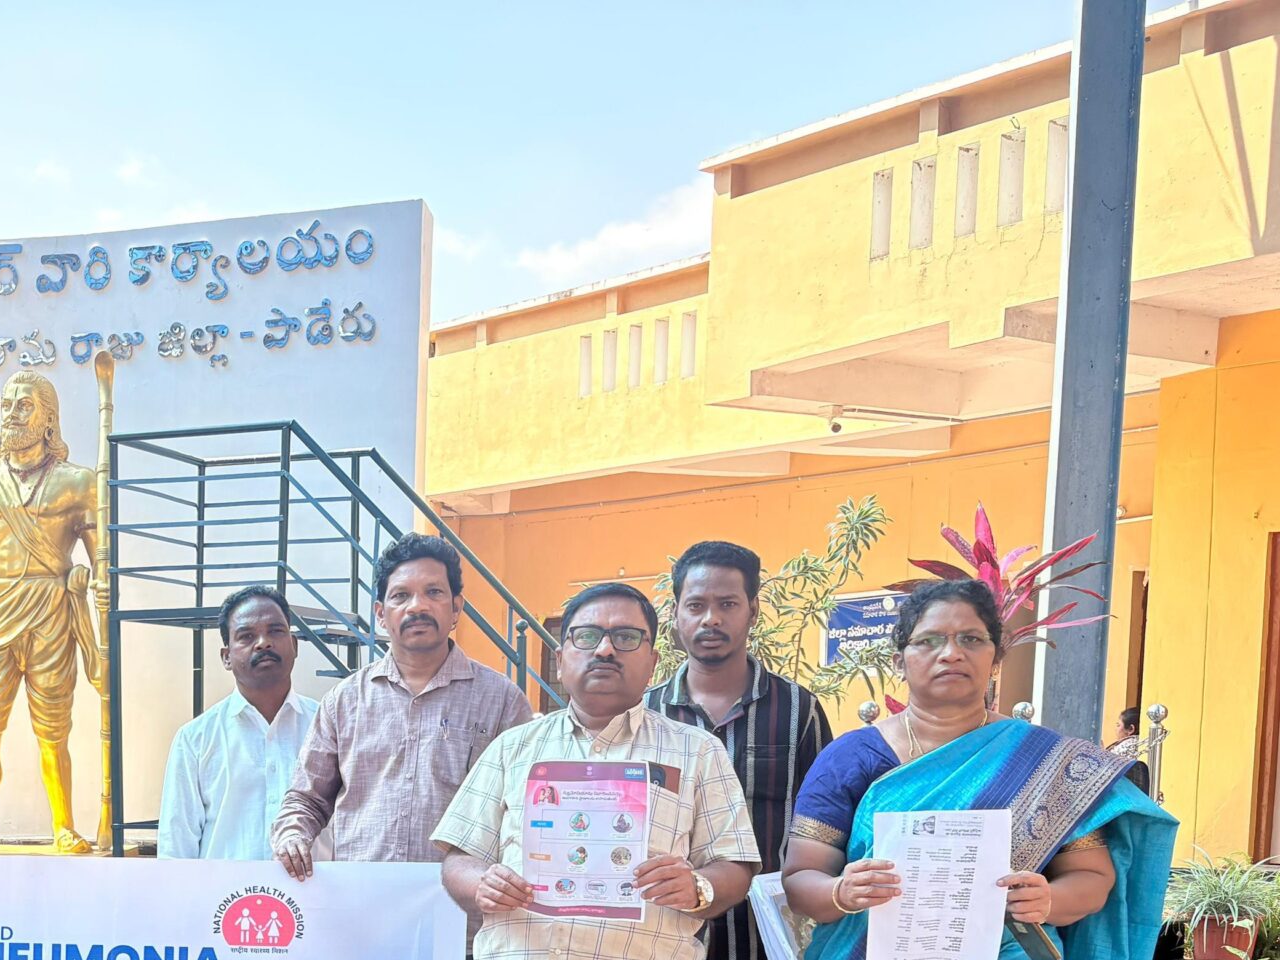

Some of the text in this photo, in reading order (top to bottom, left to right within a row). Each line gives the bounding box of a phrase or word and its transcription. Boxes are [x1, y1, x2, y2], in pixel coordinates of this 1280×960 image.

[35, 245, 111, 294] వారి
[213, 885, 305, 940] NATIONAL HEALTH MISSION
